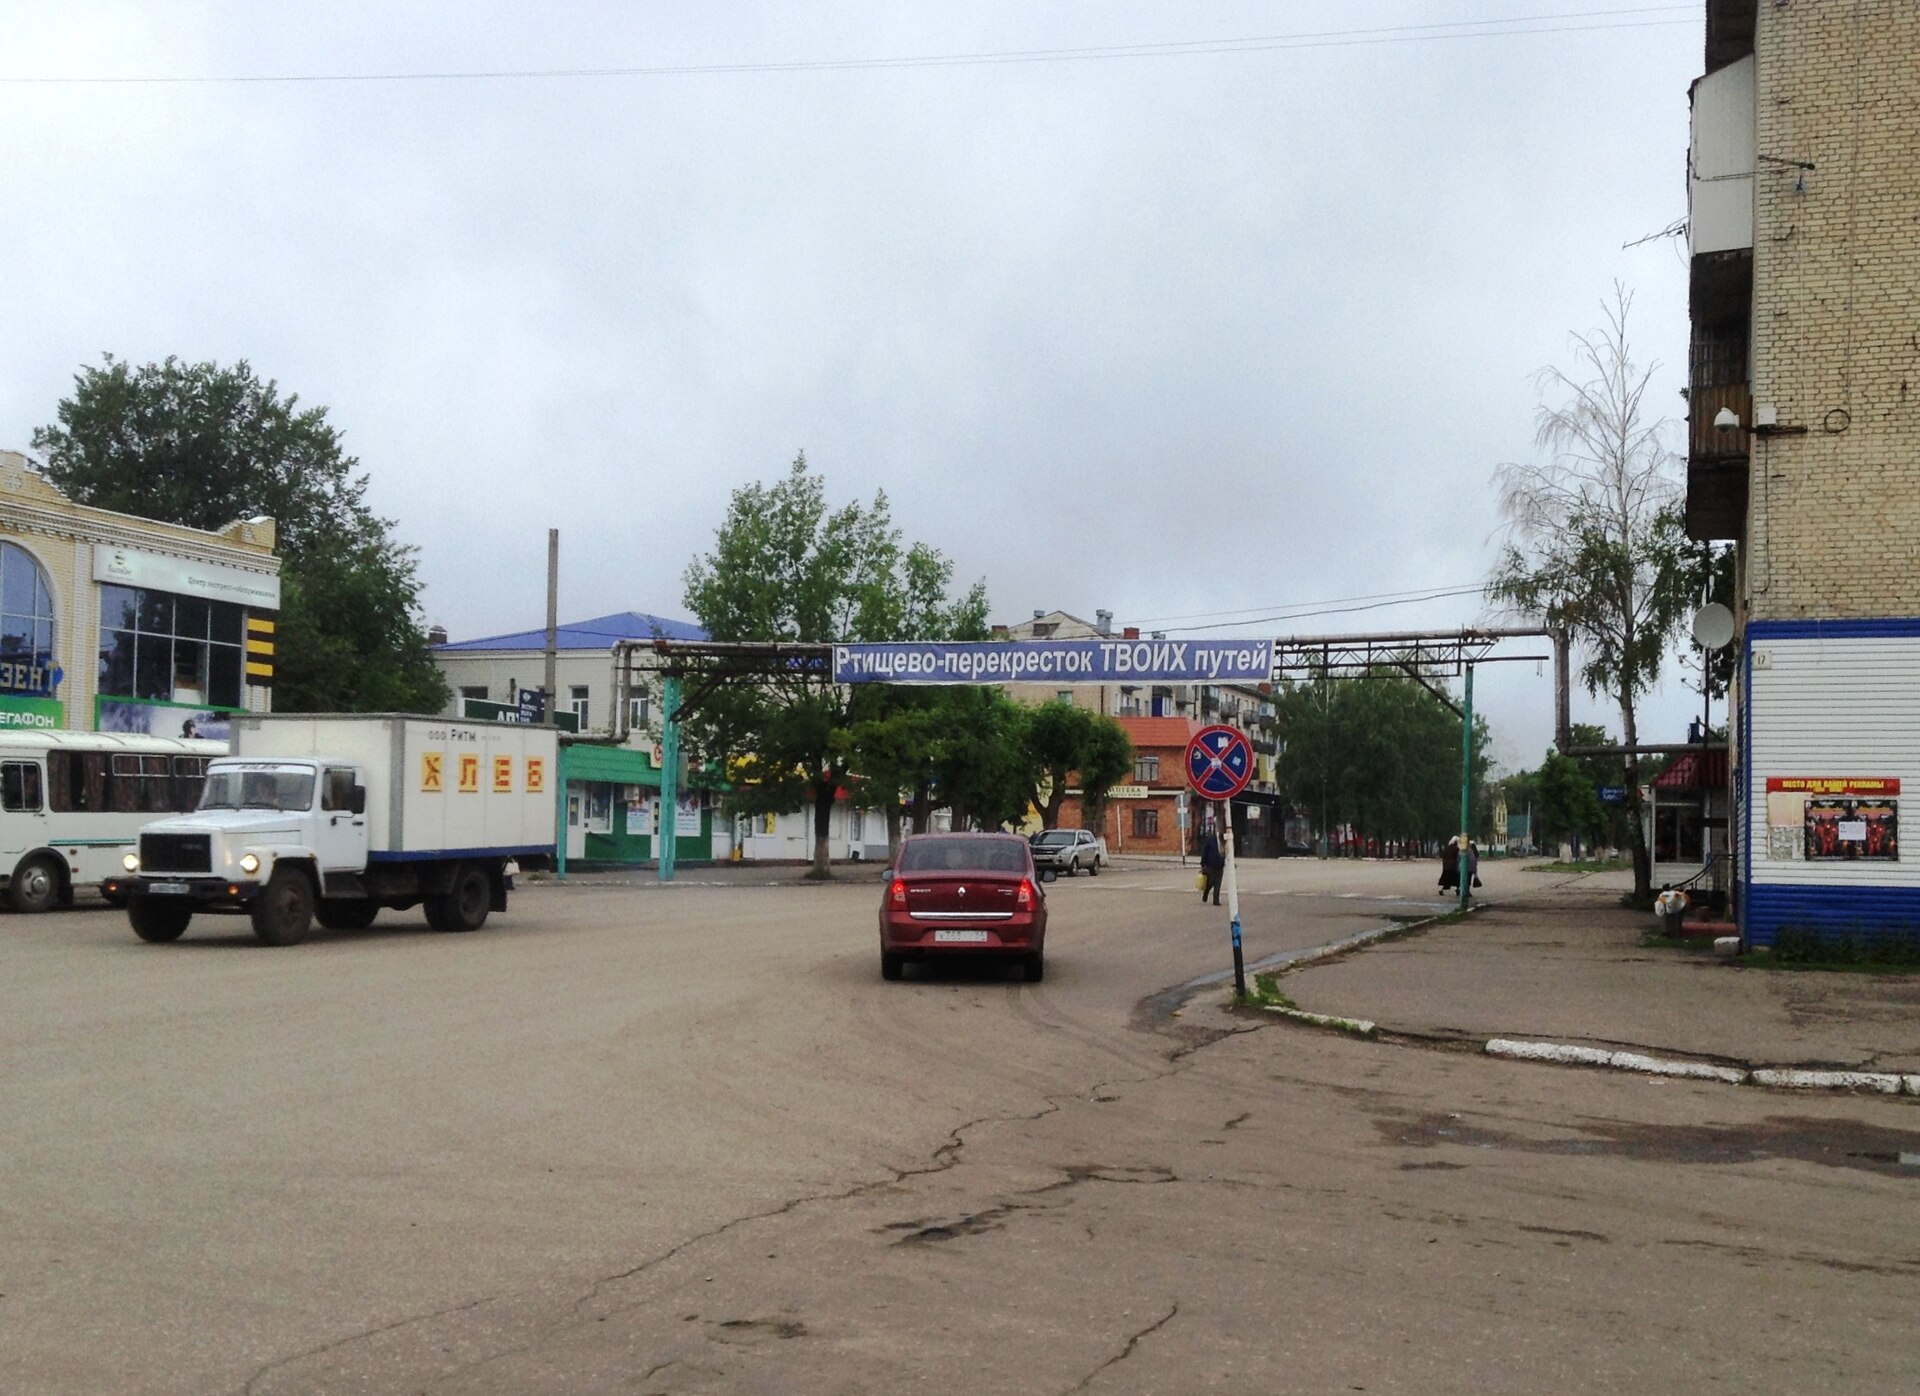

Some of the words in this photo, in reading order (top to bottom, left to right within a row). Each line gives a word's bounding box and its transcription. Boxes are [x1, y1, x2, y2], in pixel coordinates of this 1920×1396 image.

[836, 646, 1093, 679] Ртищево-перекресток
[1100, 643, 1188, 672] ТВОИХ
[1194, 642, 1268, 678] путей
[424, 756, 541, 787] ХЛЕБ
